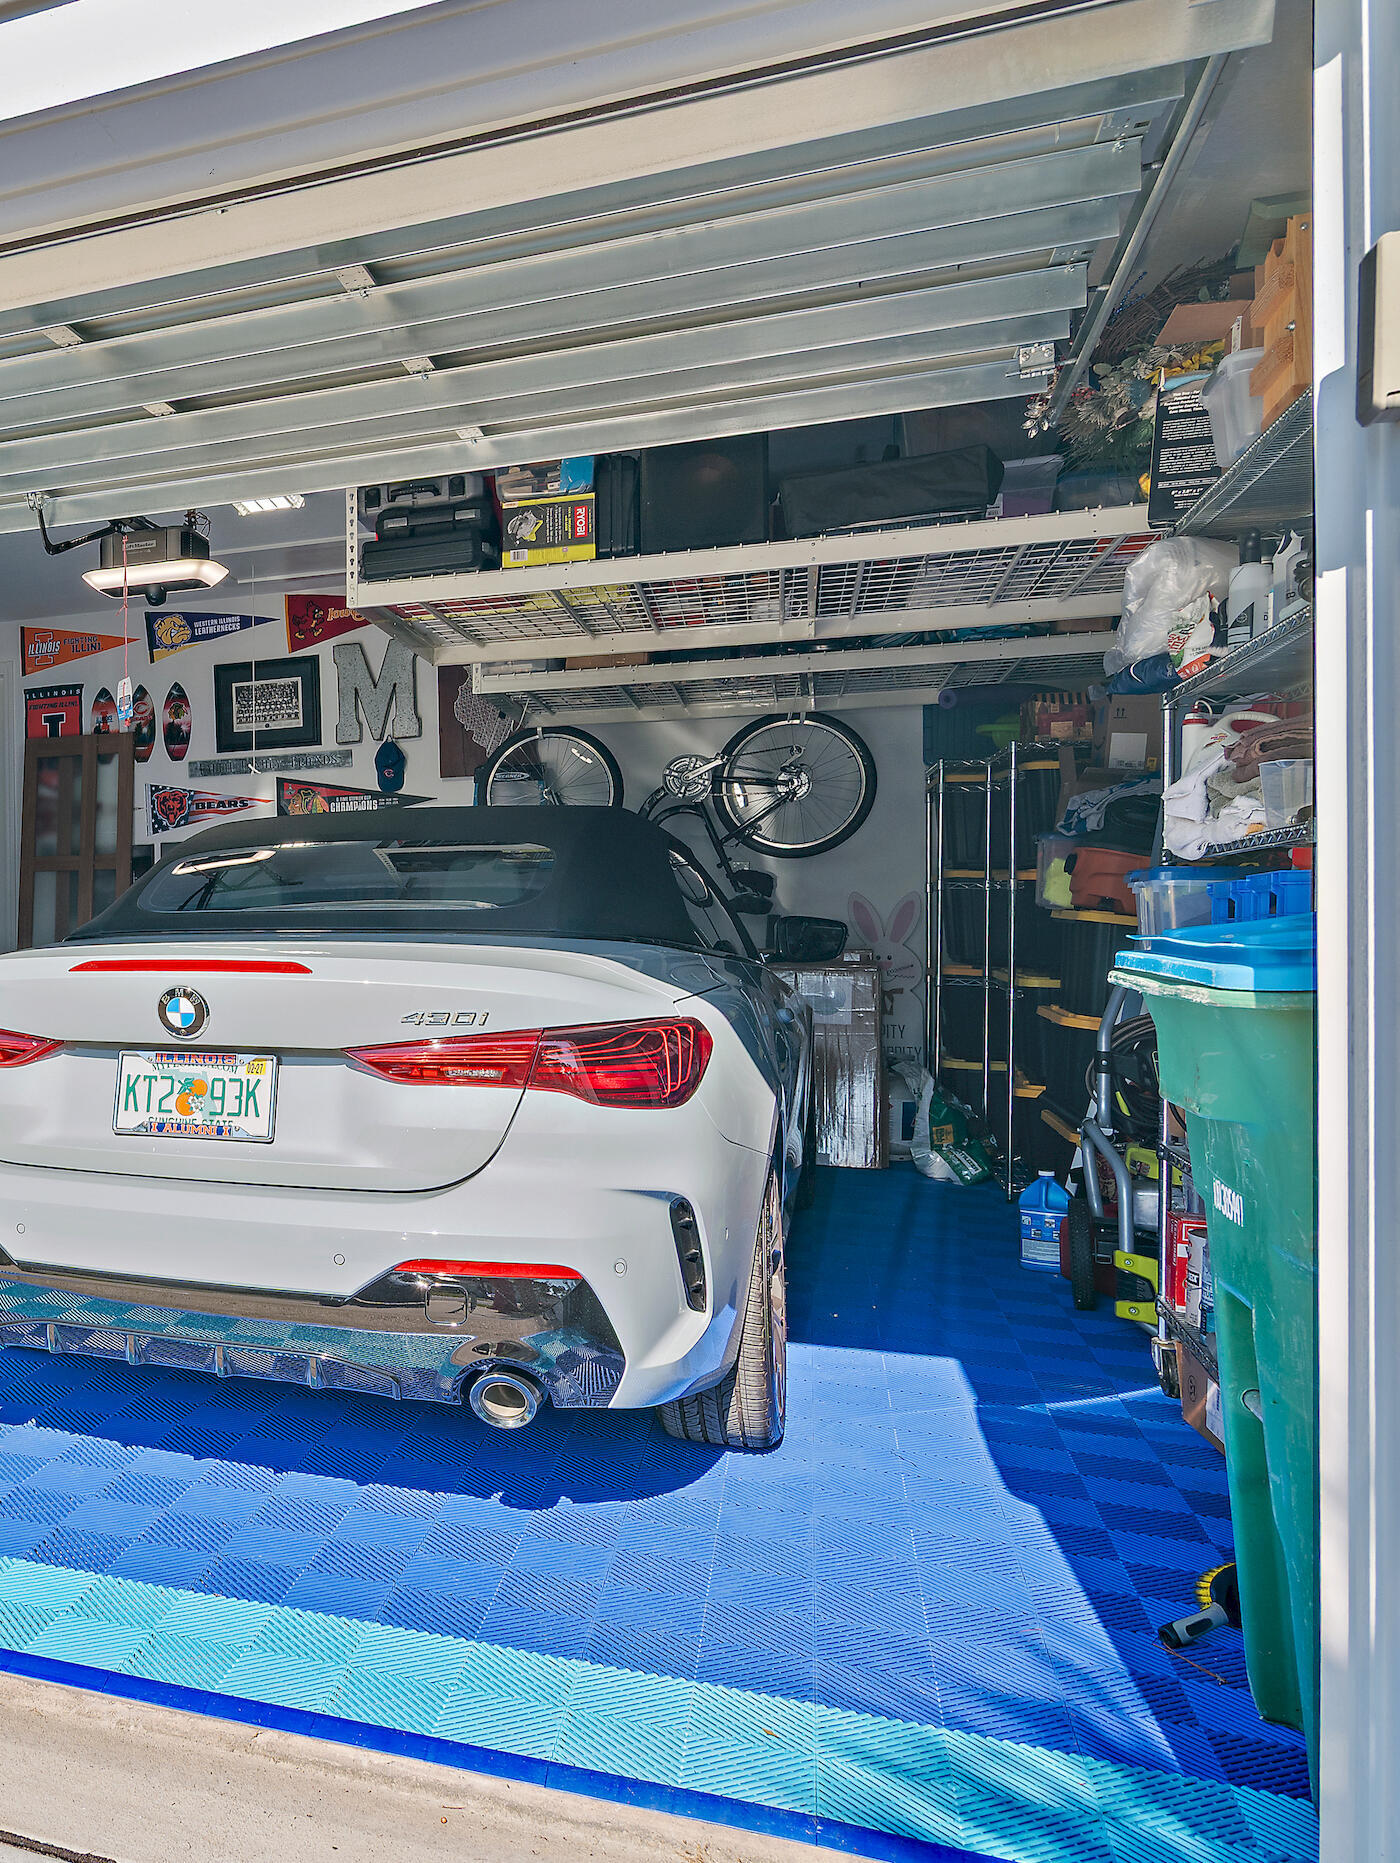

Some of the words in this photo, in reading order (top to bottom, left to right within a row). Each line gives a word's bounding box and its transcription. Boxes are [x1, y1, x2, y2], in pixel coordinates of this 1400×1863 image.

[576, 507, 586, 536] RYOBI
[194, 619, 217, 628] WESTERN
[219, 616, 241, 625] ILLINOIS
[195, 622, 241, 636] LEATHERNECKS
[63, 636, 98, 645] FIGHTING
[28, 640, 61, 655] ILLINOIS
[26, 689, 81, 699] ILLINOIS
[333, 640, 422, 744] M
[196, 799, 249, 811] BEARS
[156, 1053, 236, 1065] ILLINOIS
[124, 1074, 175, 1113] KT2
[209, 1078, 262, 1118] 93K
[163, 1123, 217, 1135] ALUMNI
